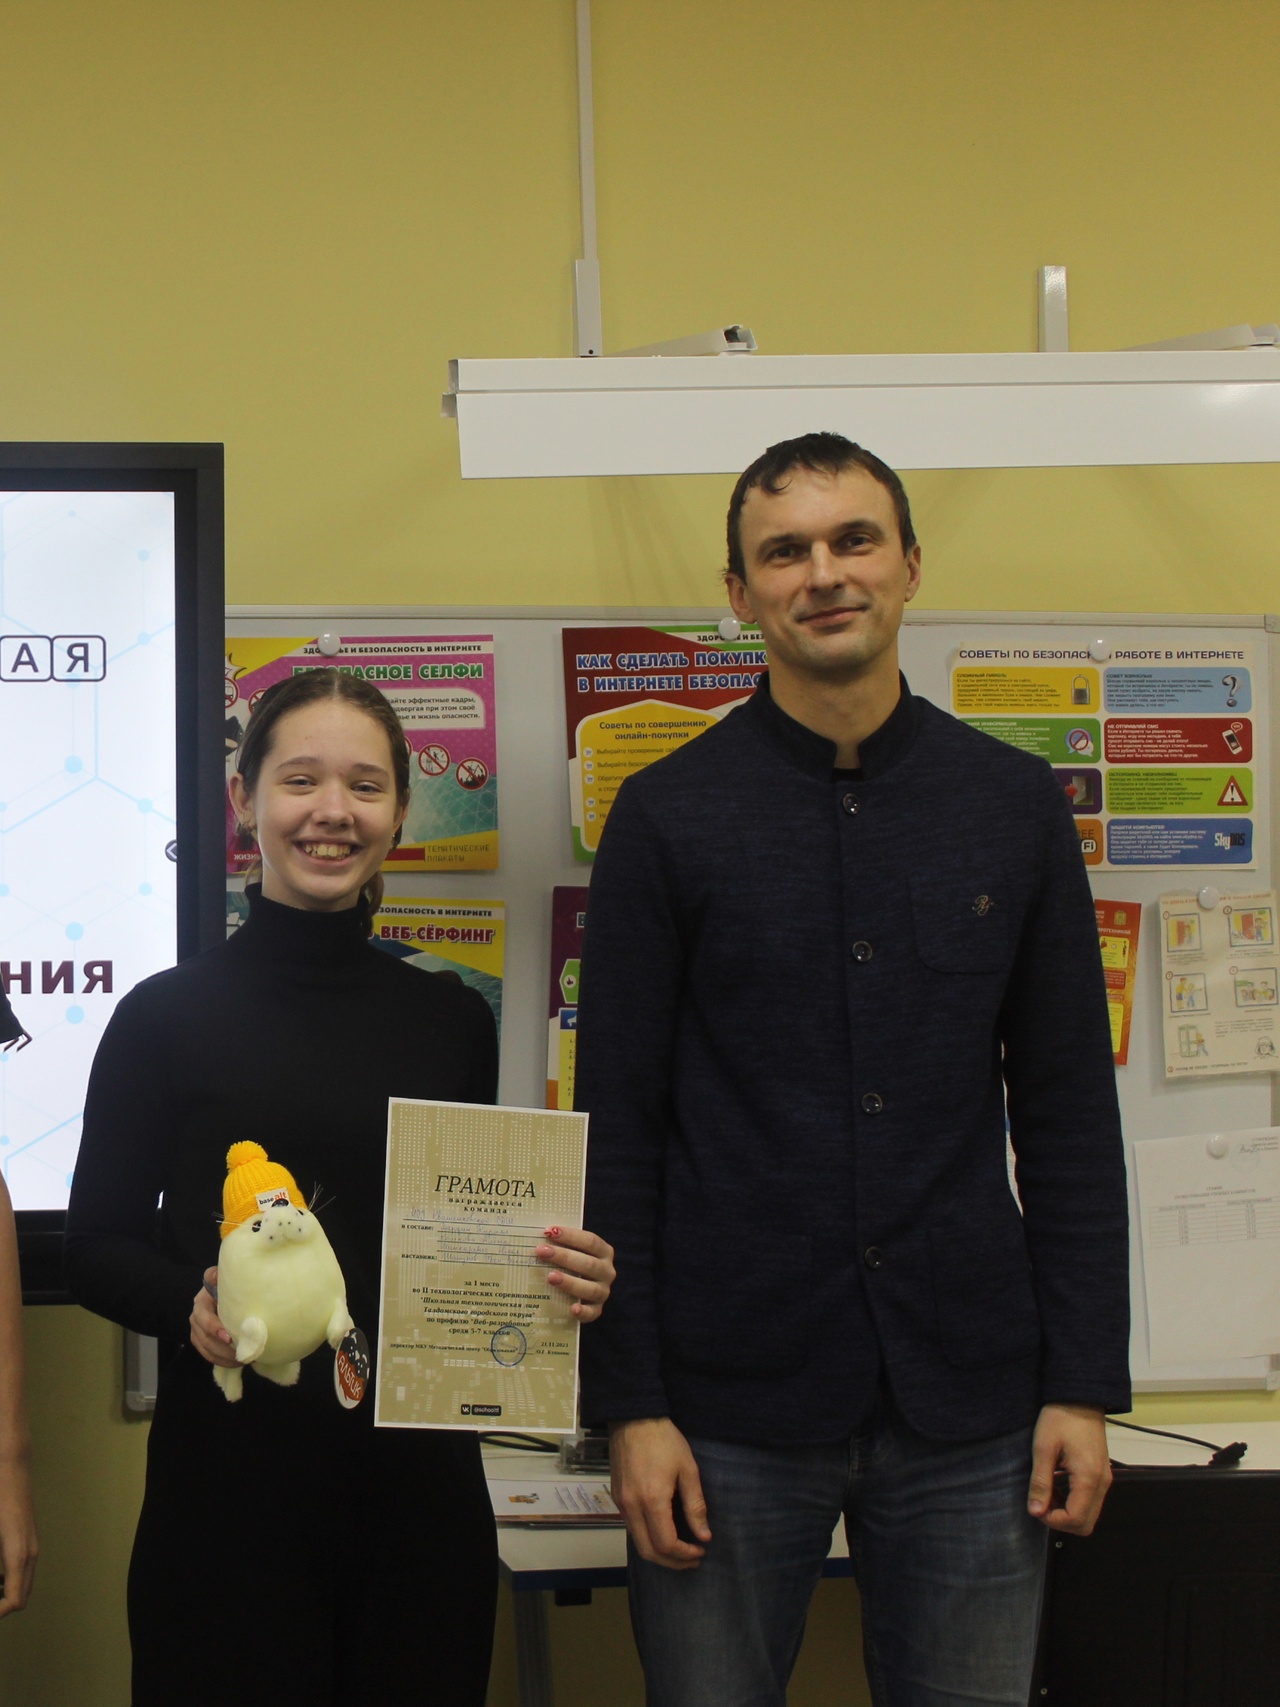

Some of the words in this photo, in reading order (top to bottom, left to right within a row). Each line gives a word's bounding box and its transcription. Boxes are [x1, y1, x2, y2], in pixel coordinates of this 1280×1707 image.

[359, 645, 425, 653] БЕЗОПАСНОСТЬ
[959, 650, 1010, 659] СОВЕТЫ
[1014, 650, 1029, 659] ПО
[1033, 650, 1111, 659] БЕЗОПАС
[1115, 650, 1161, 659] РАБОТЕ
[1165, 651, 1173, 659] В
[1176, 651, 1244, 660] ИНТЕРНЕТЕ
[576, 653, 613, 670] КАК
[616, 652, 689, 672] СДЕЛАТЬ
[694, 650, 768, 667] ПОКУПК
[419, 663, 484, 680] СЕЛФИ
[577, 676, 590, 692] В
[594, 675, 684, 693] ИНТЕРНЕТЕ
[600, 721, 633, 729] Советы
[648, 720, 707, 730] совершению
[615, 731, 690, 741] онлайн-покупки
[378, 906, 435, 914] ЗОПАСНОСТЬ
[445, 909, 492, 917] ИНТЕРНЕТЕ
[380, 924, 495, 943] ВЕБ-СЁРФИНГ
[435, 1175, 536, 1199] ГРАМОТА
[448, 1197, 522, 1208] награждается
[463, 1205, 508, 1214] команда
[401, 1253, 437, 1261] наставник:
[430, 1287, 493, 1298] технологических
[495, 1292, 551, 1301] соревнованиях
[424, 1306, 469, 1316] Талдомского
[469, 1309, 508, 1318] городского
[436, 1318, 469, 1326] профилю
[448, 1327, 469, 1335] среди
[540, 1341, 569, 1349] 21.11.2023
[338, 1355, 362, 1398] АЛЬТИК
